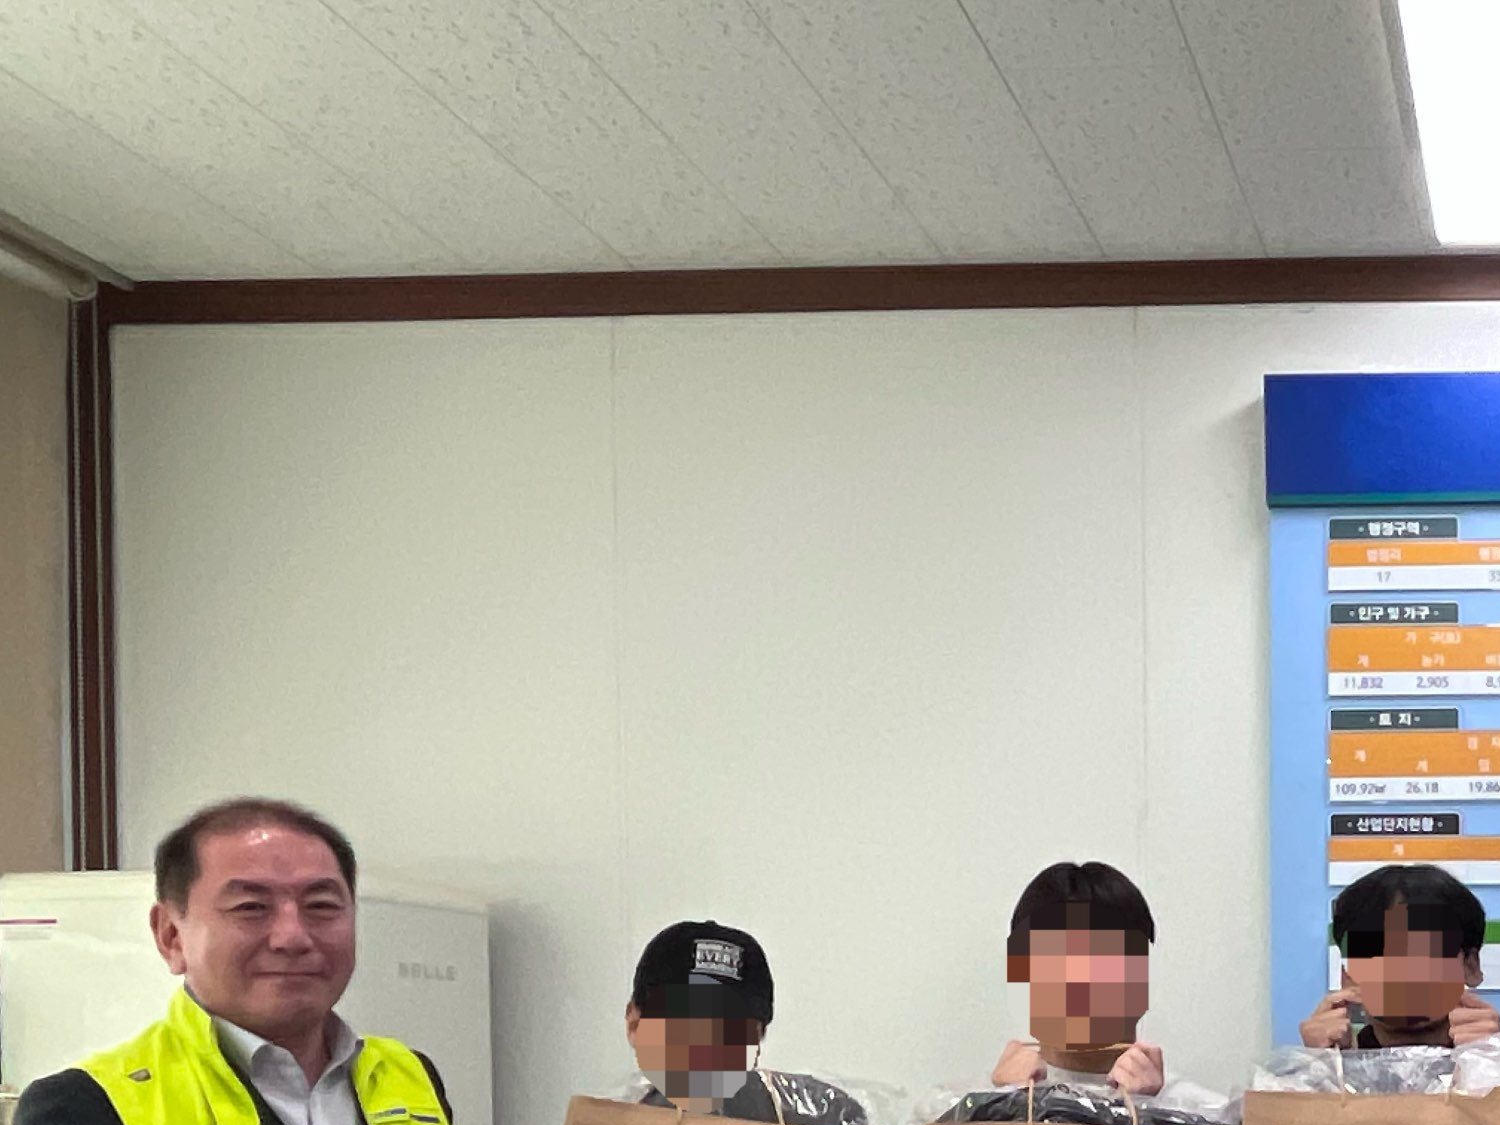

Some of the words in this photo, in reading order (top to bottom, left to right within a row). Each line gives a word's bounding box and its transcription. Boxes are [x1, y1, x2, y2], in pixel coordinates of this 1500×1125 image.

[1376, 571, 1392, 584] 17
[1403, 605, 1431, 621] 가구
[1343, 676, 1384, 690] 11,832
[1415, 675, 1450, 690] 2,905
[1405, 781, 1440, 795] 26.18
